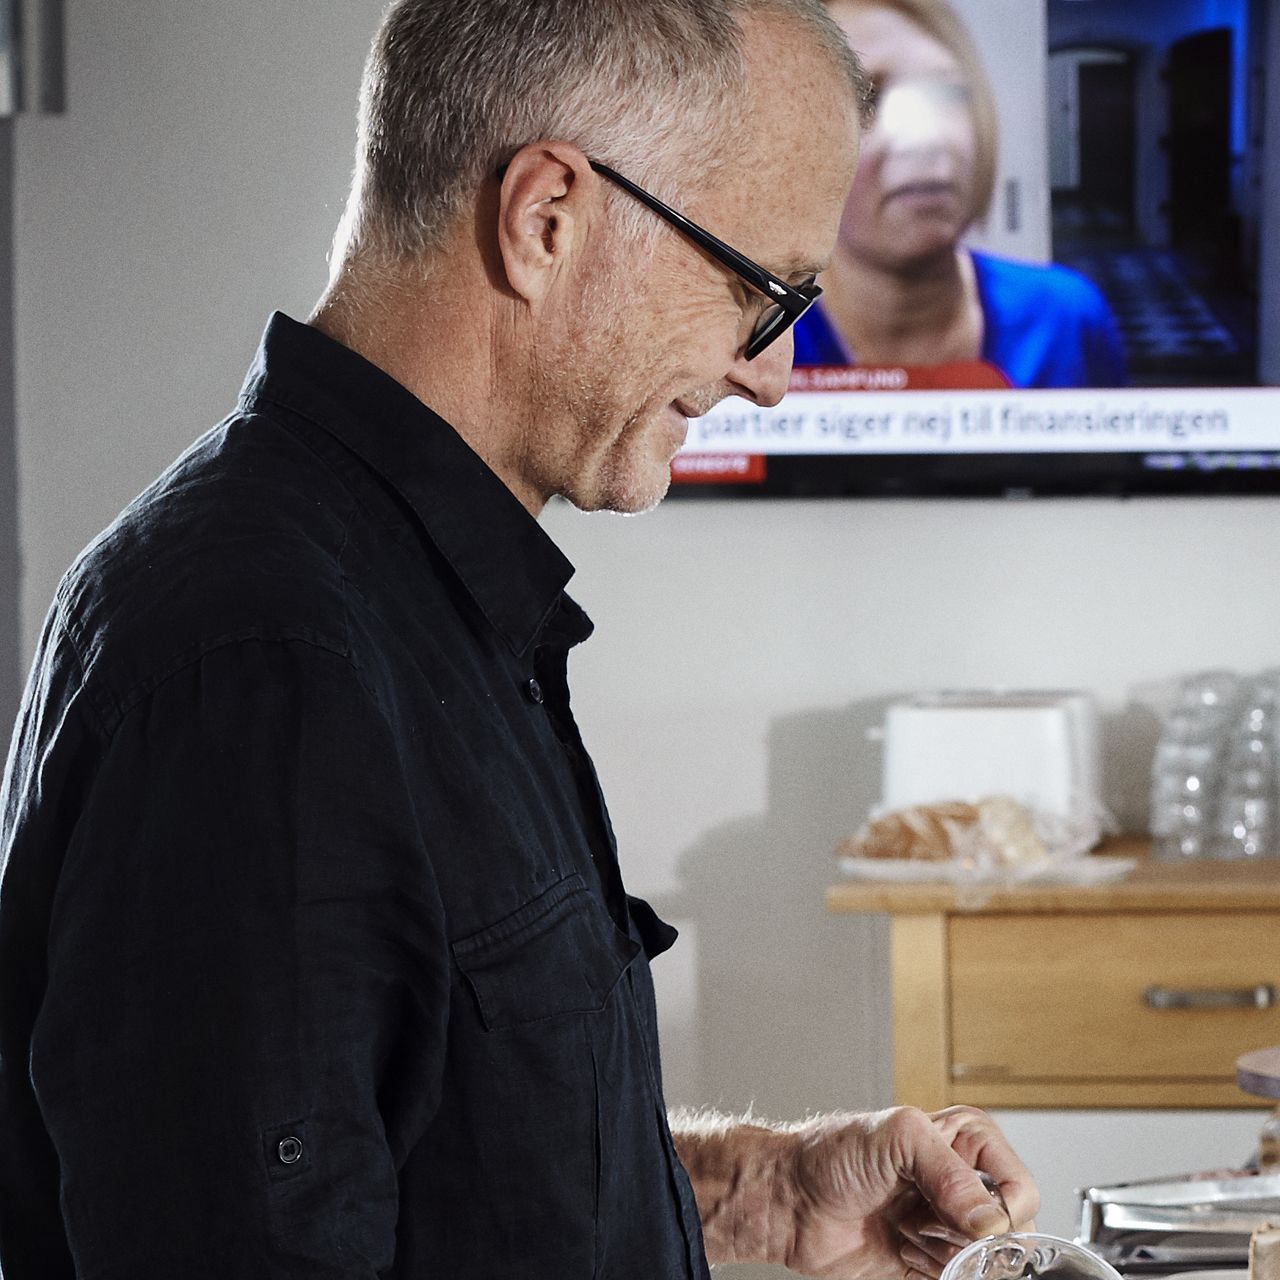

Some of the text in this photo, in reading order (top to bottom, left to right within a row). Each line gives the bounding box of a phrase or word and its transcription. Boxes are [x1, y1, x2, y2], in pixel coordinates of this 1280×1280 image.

[816, 402, 891, 439] siger
[903, 404, 952, 442] nej
[960, 403, 993, 434] til
[1000, 402, 1230, 437] finansieringen
